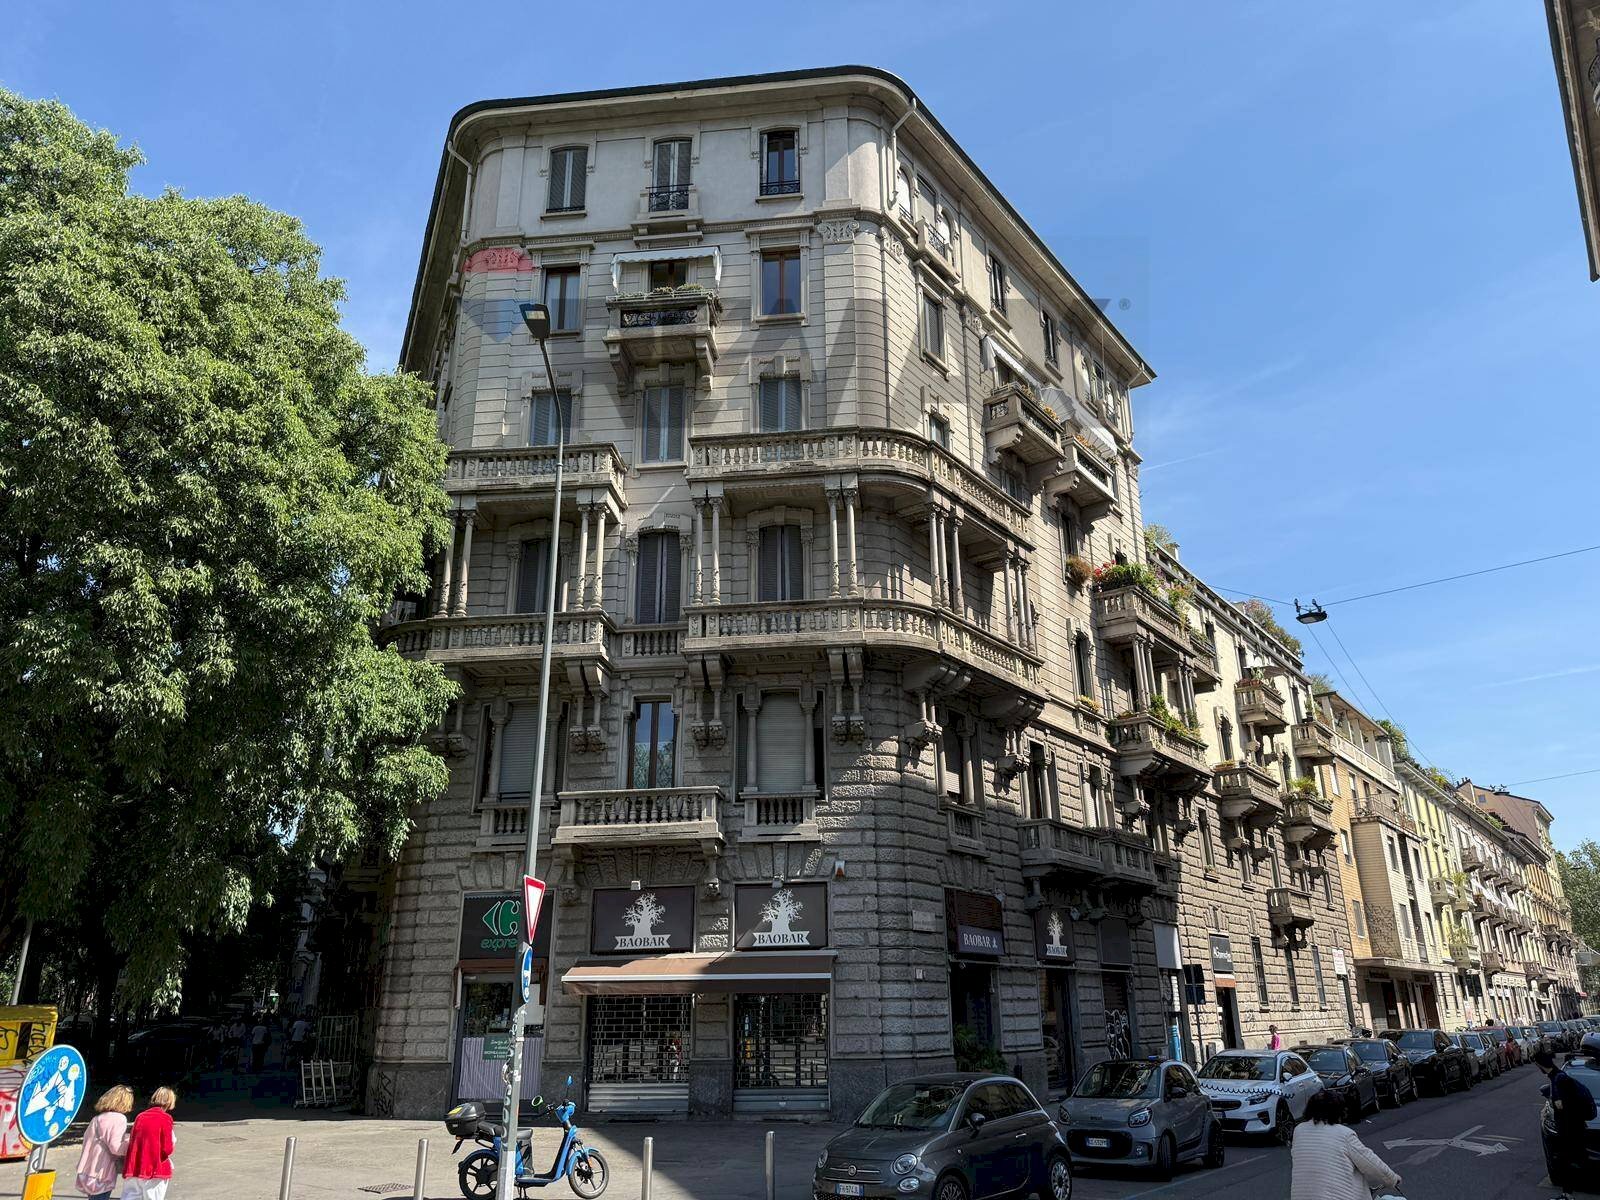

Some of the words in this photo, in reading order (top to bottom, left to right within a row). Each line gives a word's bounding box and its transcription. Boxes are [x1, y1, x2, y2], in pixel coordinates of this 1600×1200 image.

[480, 938, 518, 951] expre
[619, 936, 666, 948] BAOBAR
[758, 934, 804, 945] BAOBAR
[963, 933, 992, 949] BAOBAR
[1048, 945, 1066, 956] BAOBAR
